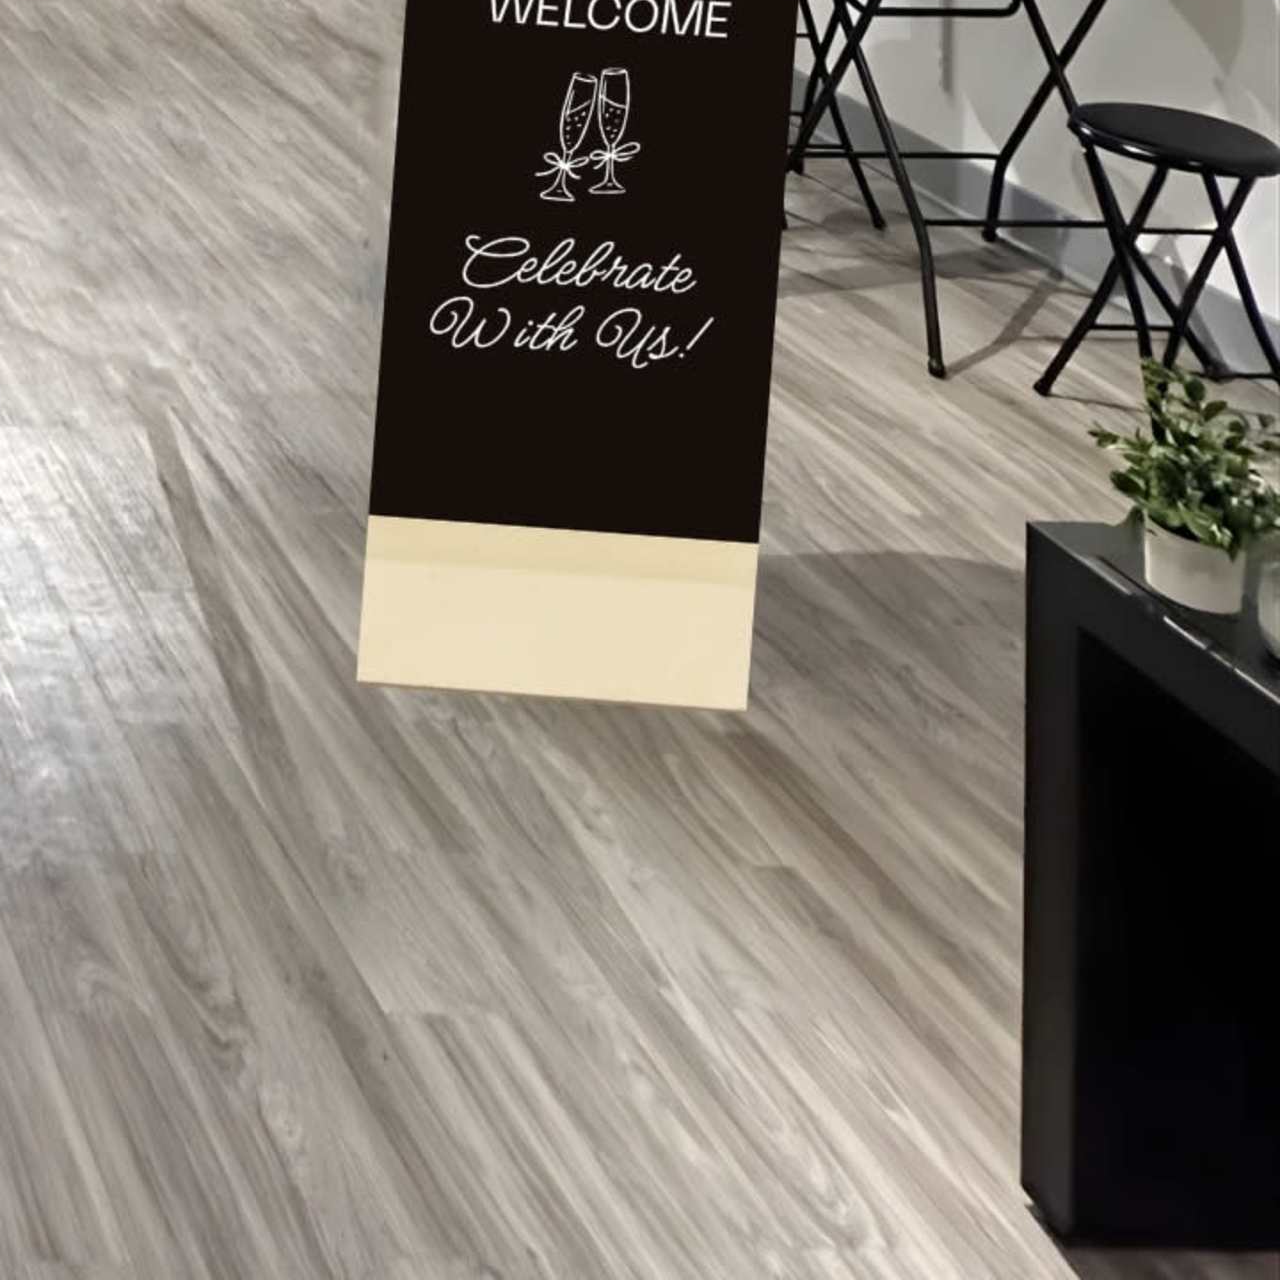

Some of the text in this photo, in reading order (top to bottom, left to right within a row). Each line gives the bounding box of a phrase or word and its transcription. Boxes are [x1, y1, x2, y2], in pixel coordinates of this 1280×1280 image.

[462, 235, 696, 293] Celebrate
[430, 296, 714, 368] With Us!
